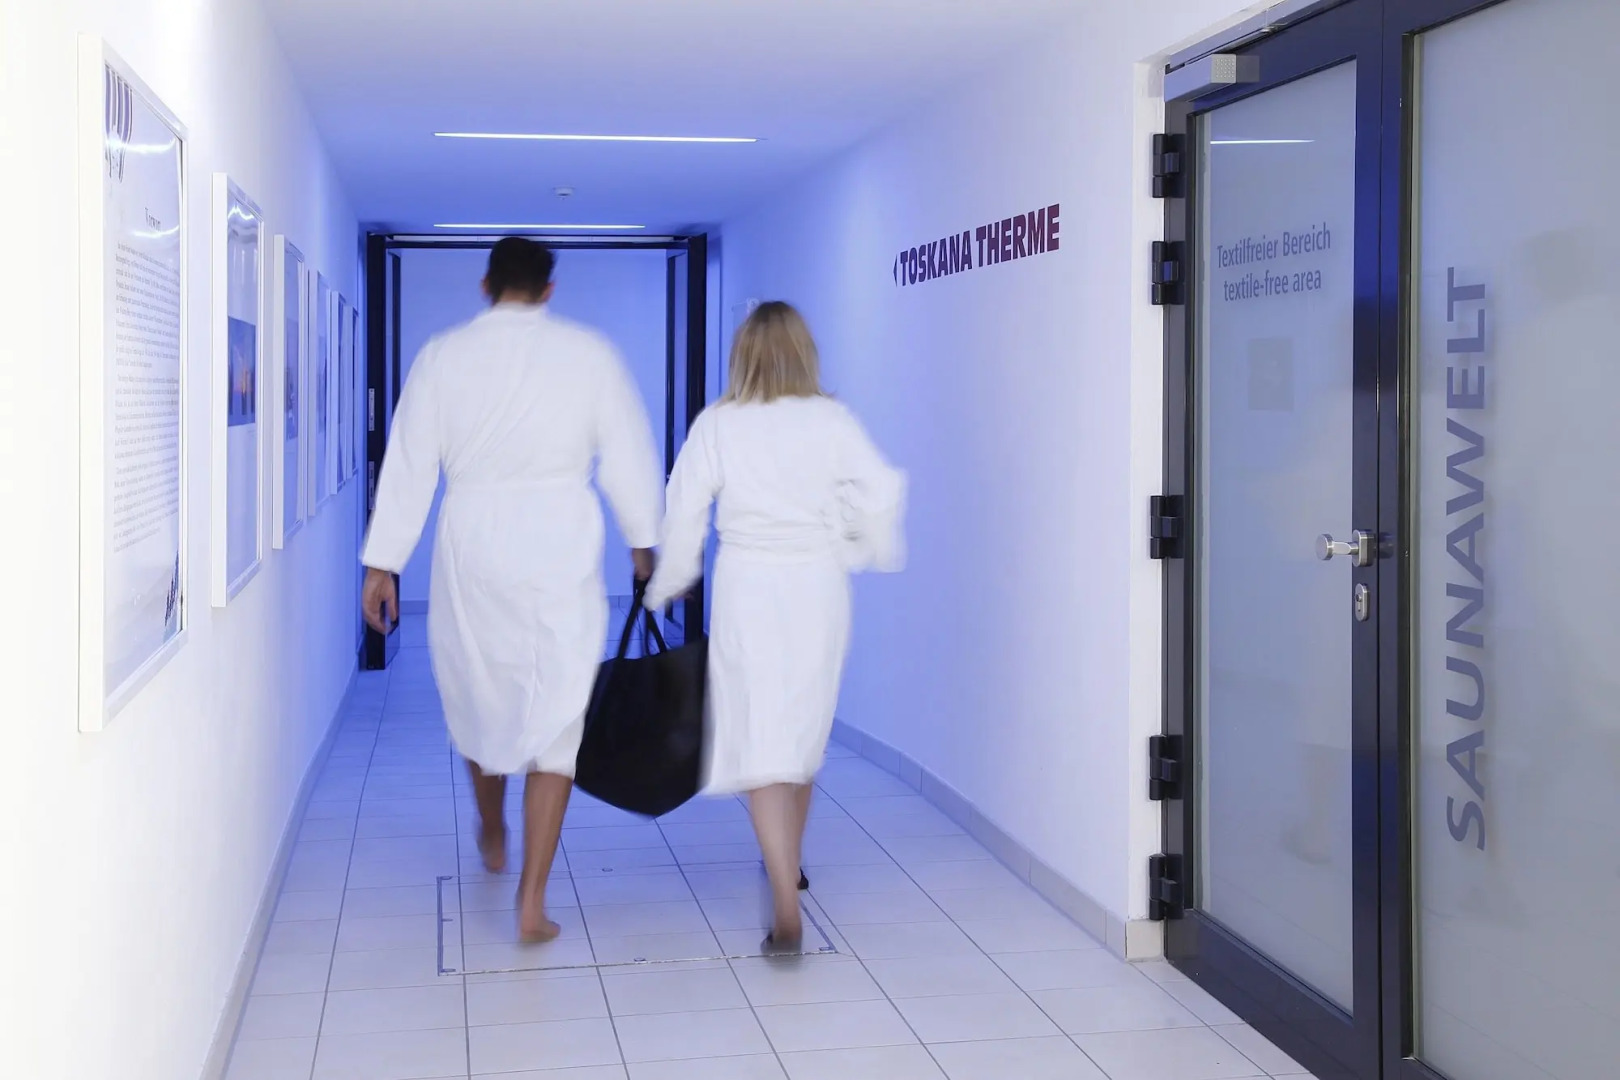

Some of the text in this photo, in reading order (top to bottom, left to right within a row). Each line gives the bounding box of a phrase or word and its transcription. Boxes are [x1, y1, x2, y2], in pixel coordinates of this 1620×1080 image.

[900, 203, 1060, 286] TOSKANA THERME
[1217, 222, 1331, 268] Textilfreier Bereich
[1224, 270, 1322, 301] textile-free area
[1446, 267, 1486, 851] SAUNAWELT
